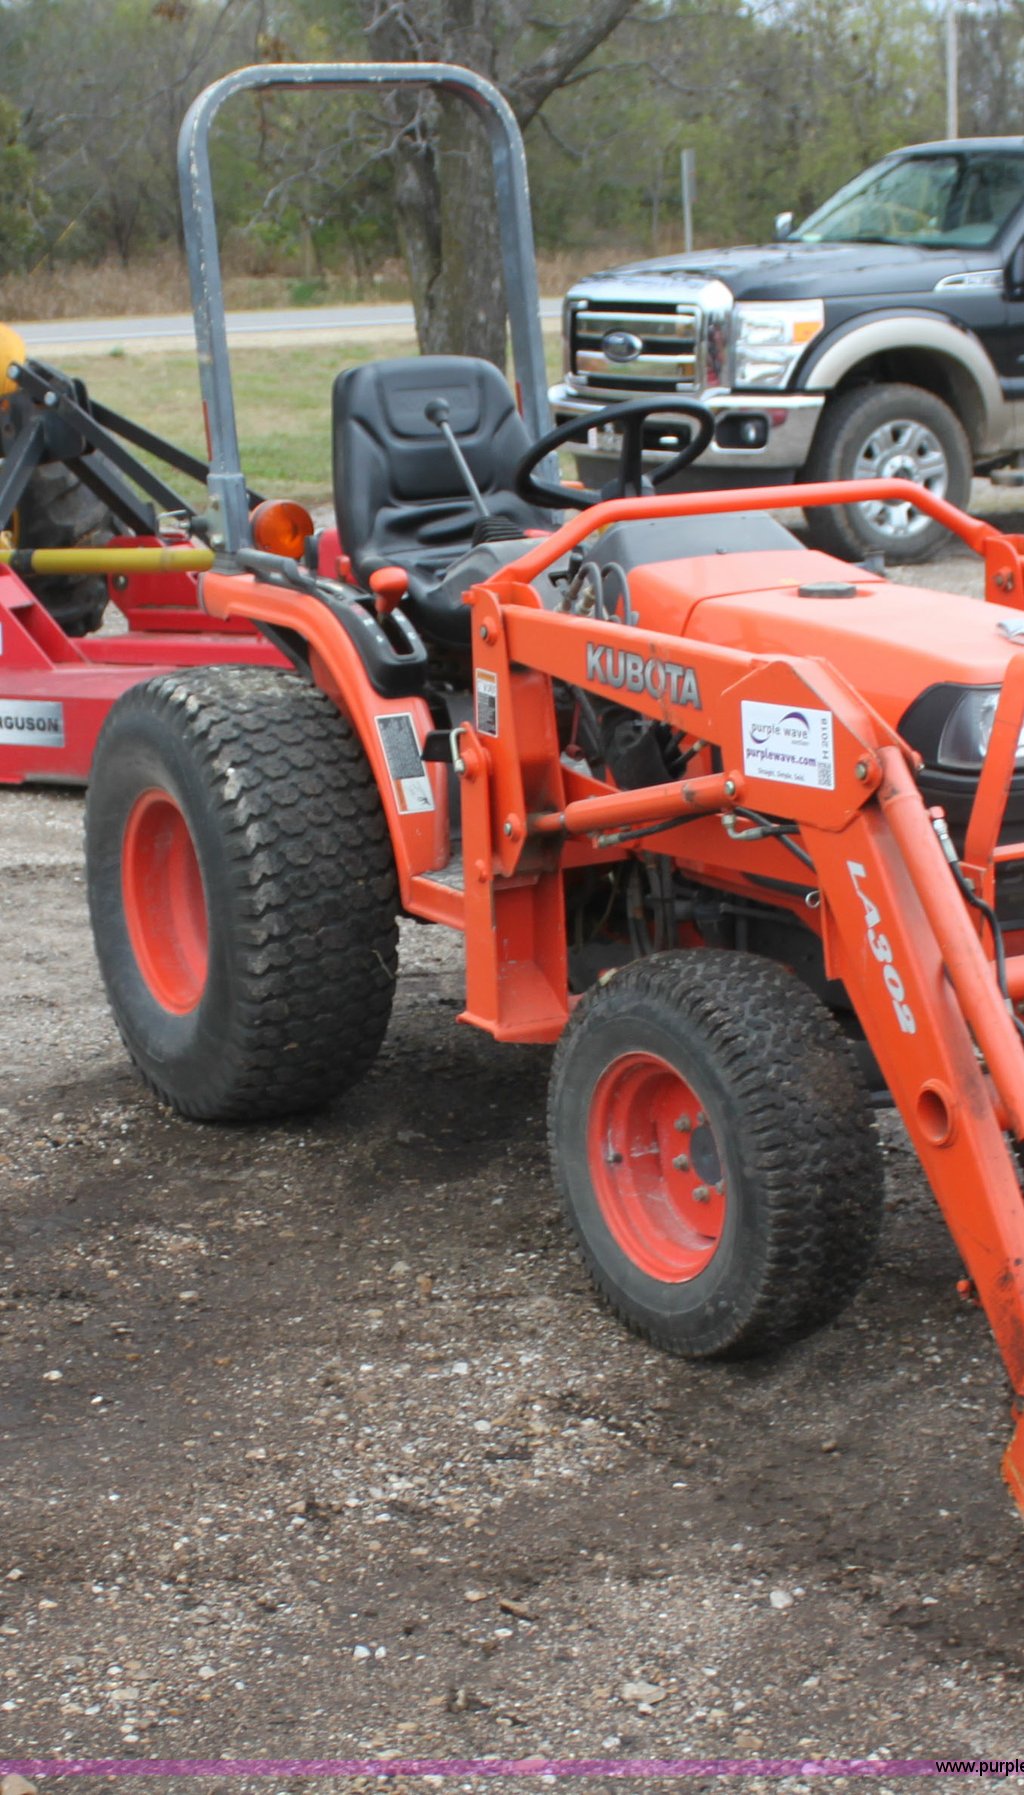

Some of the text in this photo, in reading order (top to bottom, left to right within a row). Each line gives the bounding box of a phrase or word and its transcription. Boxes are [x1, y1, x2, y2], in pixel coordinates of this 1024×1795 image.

[586, 641, 703, 711] KUBOTA
[0, 715, 59, 732] GUSON
[751, 722, 809, 739] purple wave
[746, 748, 817, 767] purplewave.com
[846, 860, 917, 1034] LA302
